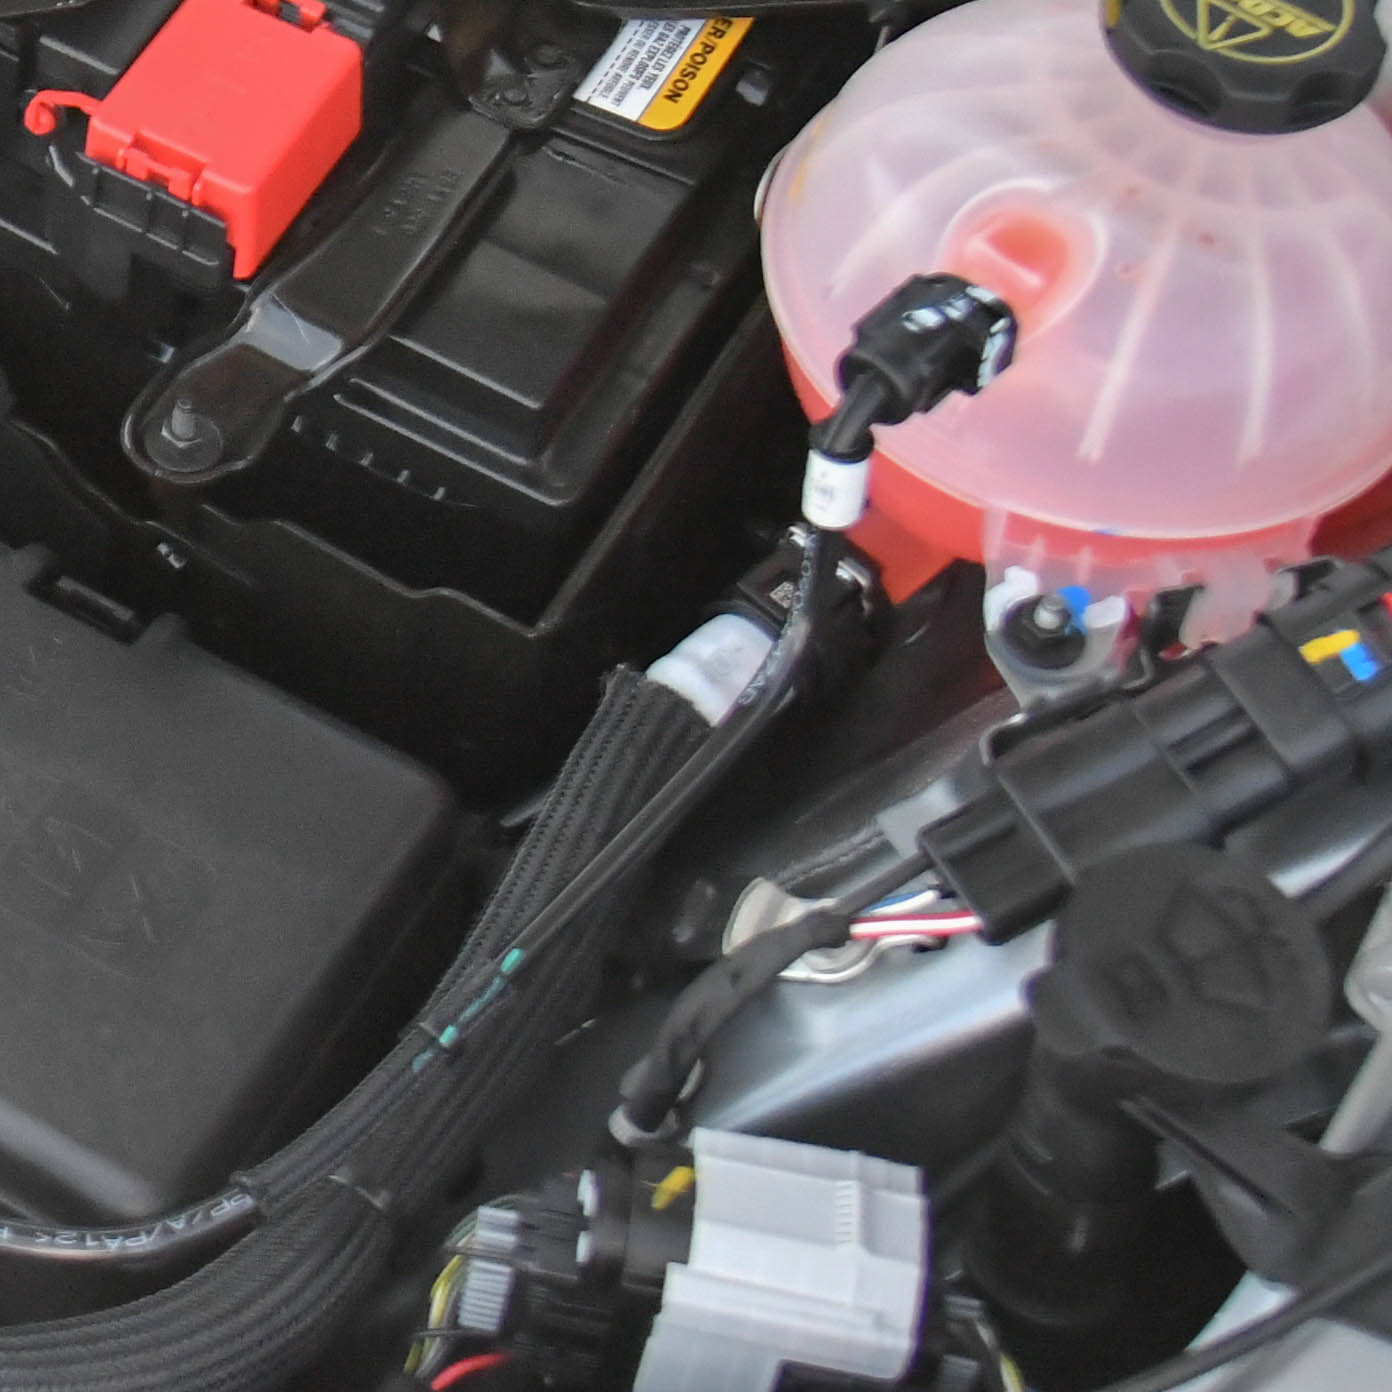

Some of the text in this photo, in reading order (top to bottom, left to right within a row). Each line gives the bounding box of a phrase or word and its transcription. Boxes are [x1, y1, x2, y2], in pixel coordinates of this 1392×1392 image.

[652, 29, 669, 48] GAZ
[628, 42, 660, 81] EXPLOSIFS
[650, 56, 668, 74] LES
